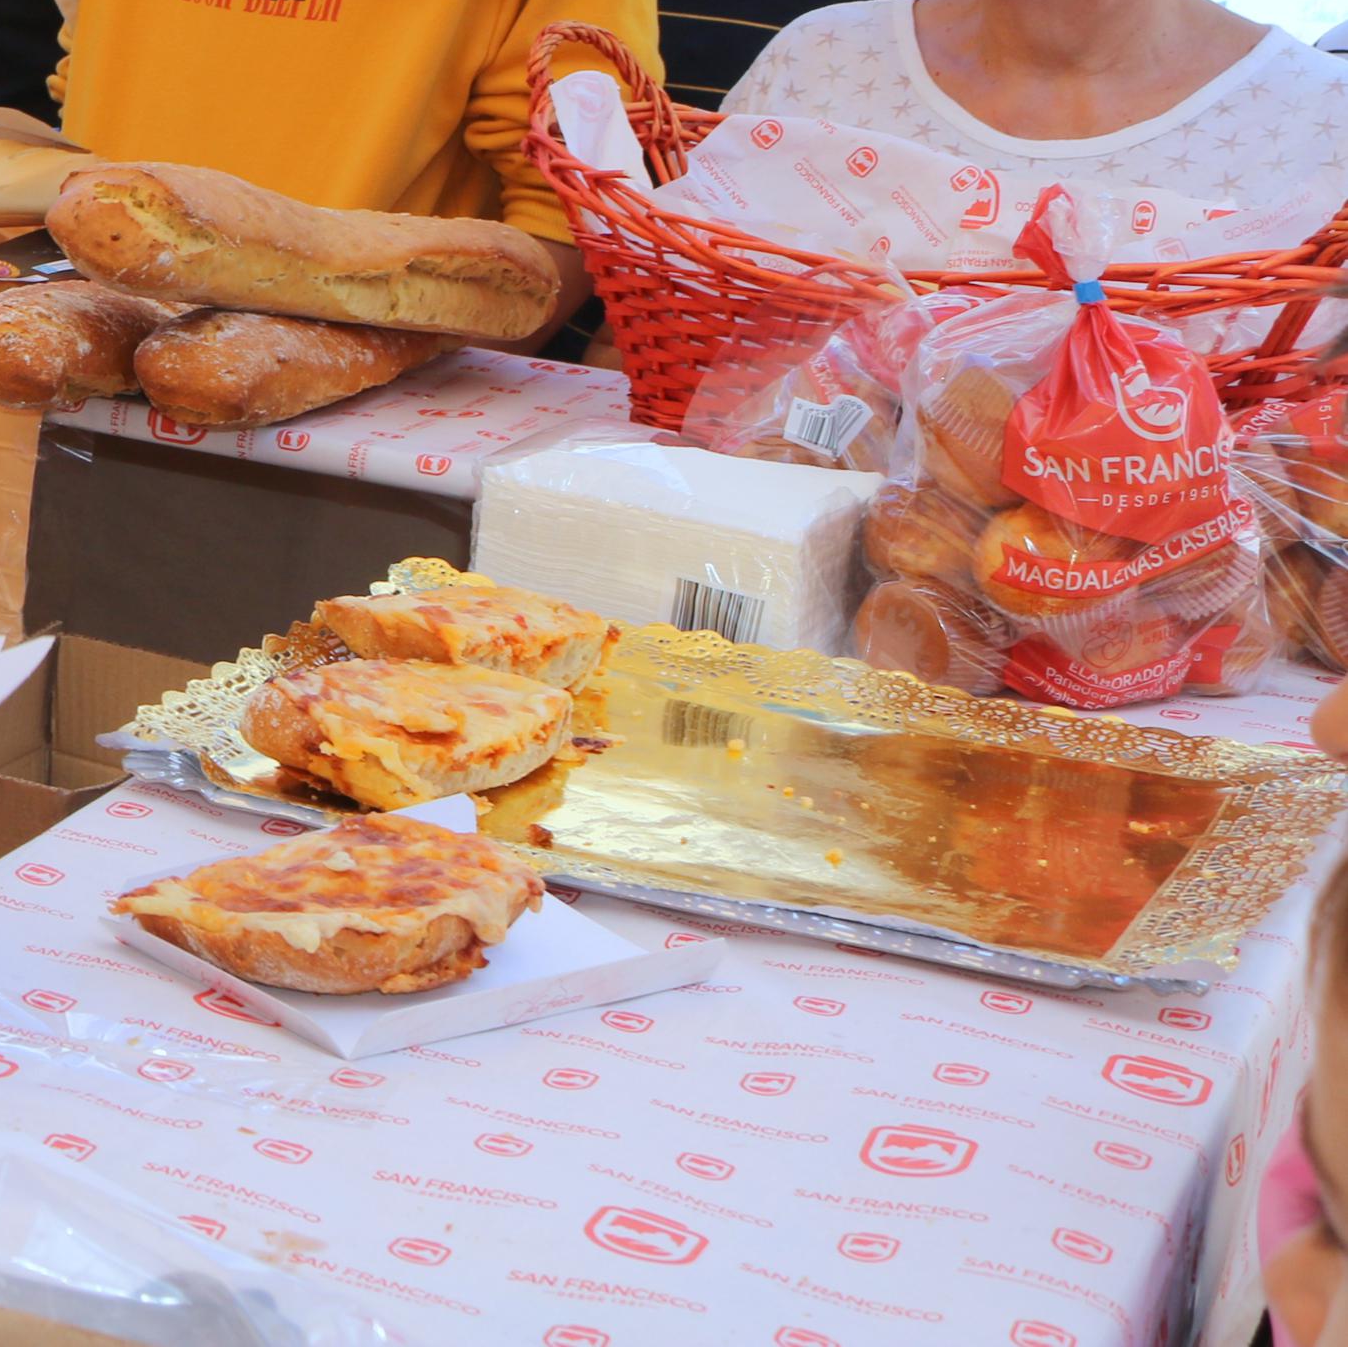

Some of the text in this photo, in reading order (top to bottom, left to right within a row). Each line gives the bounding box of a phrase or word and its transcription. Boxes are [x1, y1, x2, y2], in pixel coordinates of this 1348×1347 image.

[793, 160, 862, 229] SAN FRANCISCO
[890, 190, 927, 234] FRANCISCO
[1021, 445, 1091, 484] SAN
[1102, 484, 1219, 508] DESDE 1951
[1007, 500, 1253, 591] MAGDALENAS CASERAS
[1045, 666, 1119, 705] Panadería
[1068, 661, 1165, 690] ELABORADO
[24, 943, 175, 982] SAN FRANCISCO
[762, 958, 925, 987] SAN FRANCISCO
[120, 1015, 283, 1063] SAN FRANCISCO
[899, 1012, 1074, 1060] SAN FRANCISCO
[1087, 1017, 1131, 1034] SAN
[519, 1026, 686, 1071] SAN FRANCISCO
[704, 1035, 875, 1065] SAN FRANCISCO
[241, 1086, 412, 1126] SAN FRANCISCO
[444, 1095, 622, 1140] SAN FRANCISCO
[648, 1097, 830, 1144] SAN FRANCISCO
[850, 1086, 1037, 1129] SAN FRANCISCO
[1045, 1095, 1092, 1114] SAN
[142, 1161, 189, 1180] SAN
[194, 1172, 322, 1224] FRANCISCO
[373, 1168, 421, 1188] SAN
[425, 1178, 559, 1210] FRANCISCO
[586, 1162, 775, 1229] SAN FRANCISCO
[1007, 1164, 1055, 1185] SAN
[792, 1187, 991, 1223] SAN FRANCISCO
[287, 1252, 482, 1317] SAN FRANCISCO
[963, 1256, 1016, 1275] SAN
[507, 1268, 559, 1288] SAN
[562, 1276, 708, 1314] FRANCISCO
[740, 1261, 945, 1323] SAN FRANCISCO
